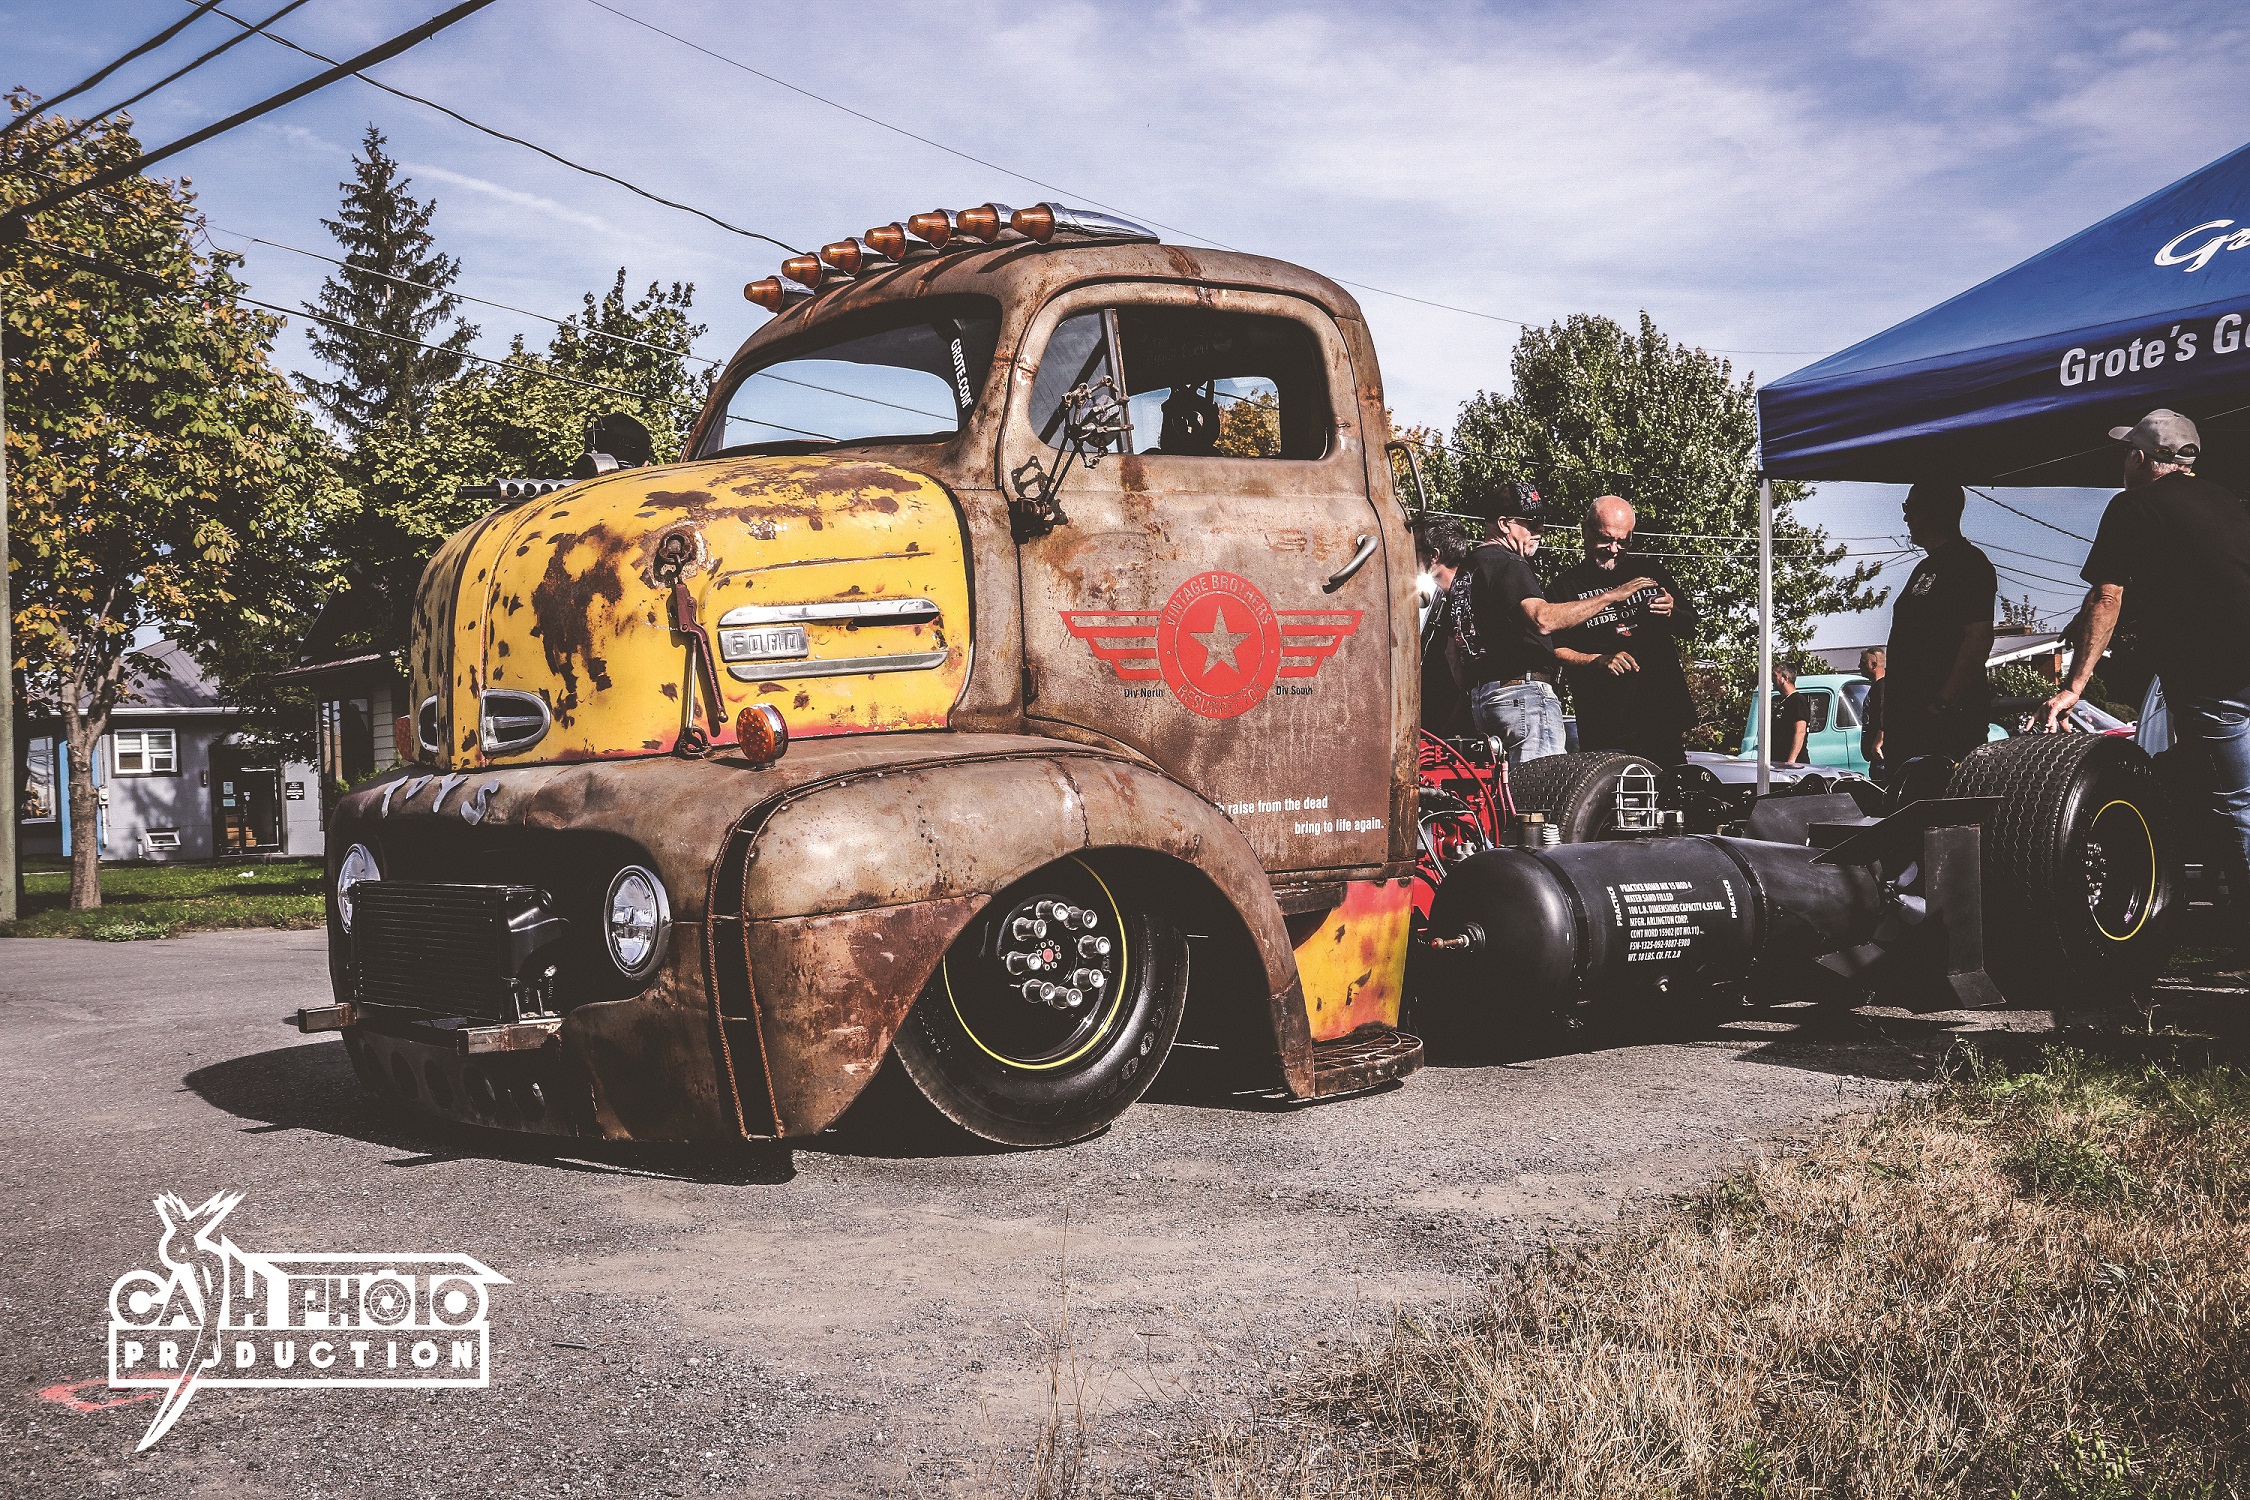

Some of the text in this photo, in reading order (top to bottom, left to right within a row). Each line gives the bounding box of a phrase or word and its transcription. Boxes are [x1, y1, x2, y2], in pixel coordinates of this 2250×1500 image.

[2060, 313, 2250, 387] Grote's G
[951, 338, 972, 408] GROTE.COM
[1164, 574, 1273, 626] VINTAGE BROTHERS
[1586, 613, 1618, 629] RIDE
[730, 633, 801, 654] FORD
[1124, 688, 1164, 698] Div North
[1276, 685, 1313, 696] Div South
[381, 772, 500, 826] TOYS
[1228, 801, 1255, 815] raise
[1258, 799, 1282, 813] from
[1285, 798, 1300, 811] the
[1304, 795, 1329, 810] dead
[1295, 820, 1321, 835] bring
[1324, 820, 1333, 833] to
[1336, 818, 1352, 832] life
[1619, 883, 1645, 892] PRACTICE
[1606, 886, 1623, 926] PRACTICE
[1624, 892, 1674, 903] WATER SAND FILLED
[1722, 880, 1738, 919] PRACTICE
[1628, 905, 1638, 914] 100
[1648, 903, 1680, 914] DIMENSIONS
[1680, 902, 1702, 912] CAPACITY
[1646, 915, 1675, 926] ARLINGTON
[1674, 915, 1689, 924] CORP.
